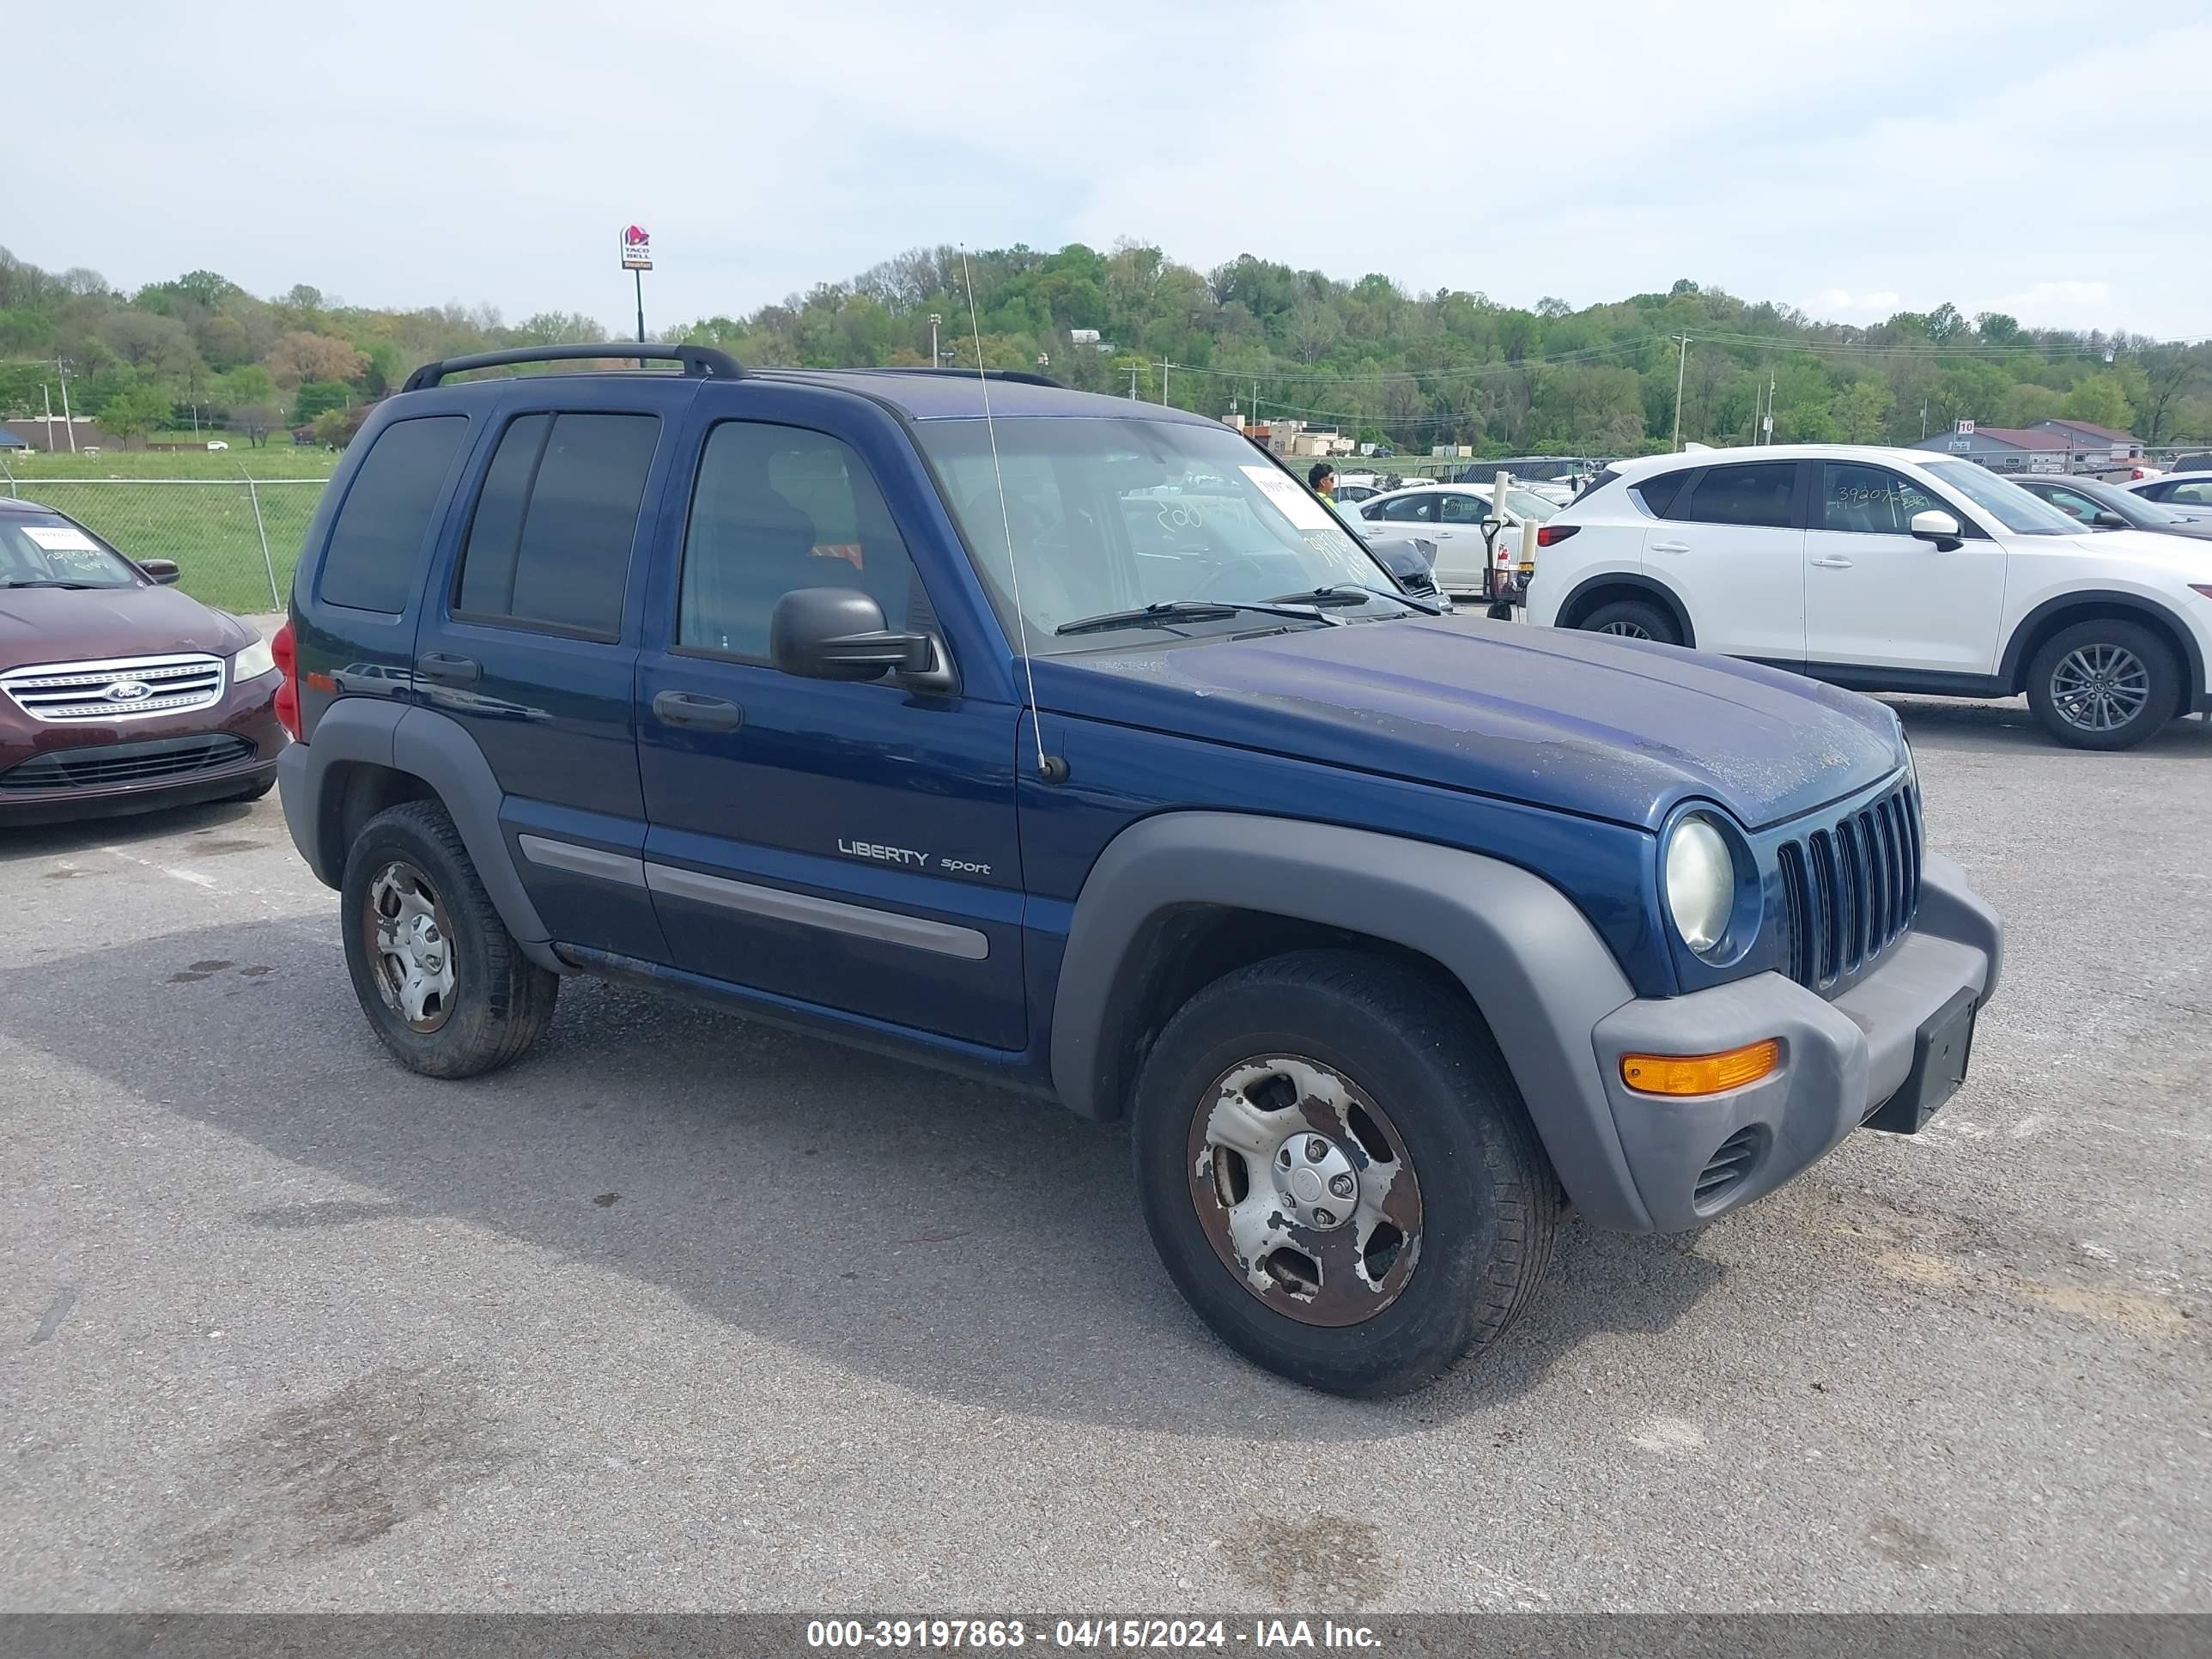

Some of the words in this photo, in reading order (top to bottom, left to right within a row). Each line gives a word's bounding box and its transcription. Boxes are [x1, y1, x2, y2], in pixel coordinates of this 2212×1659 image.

[1960, 422, 1972, 432] 10
[118, 685, 143, 698] Ford
[837, 838, 930, 867] LIBERTY
[940, 856, 992, 875] sport
